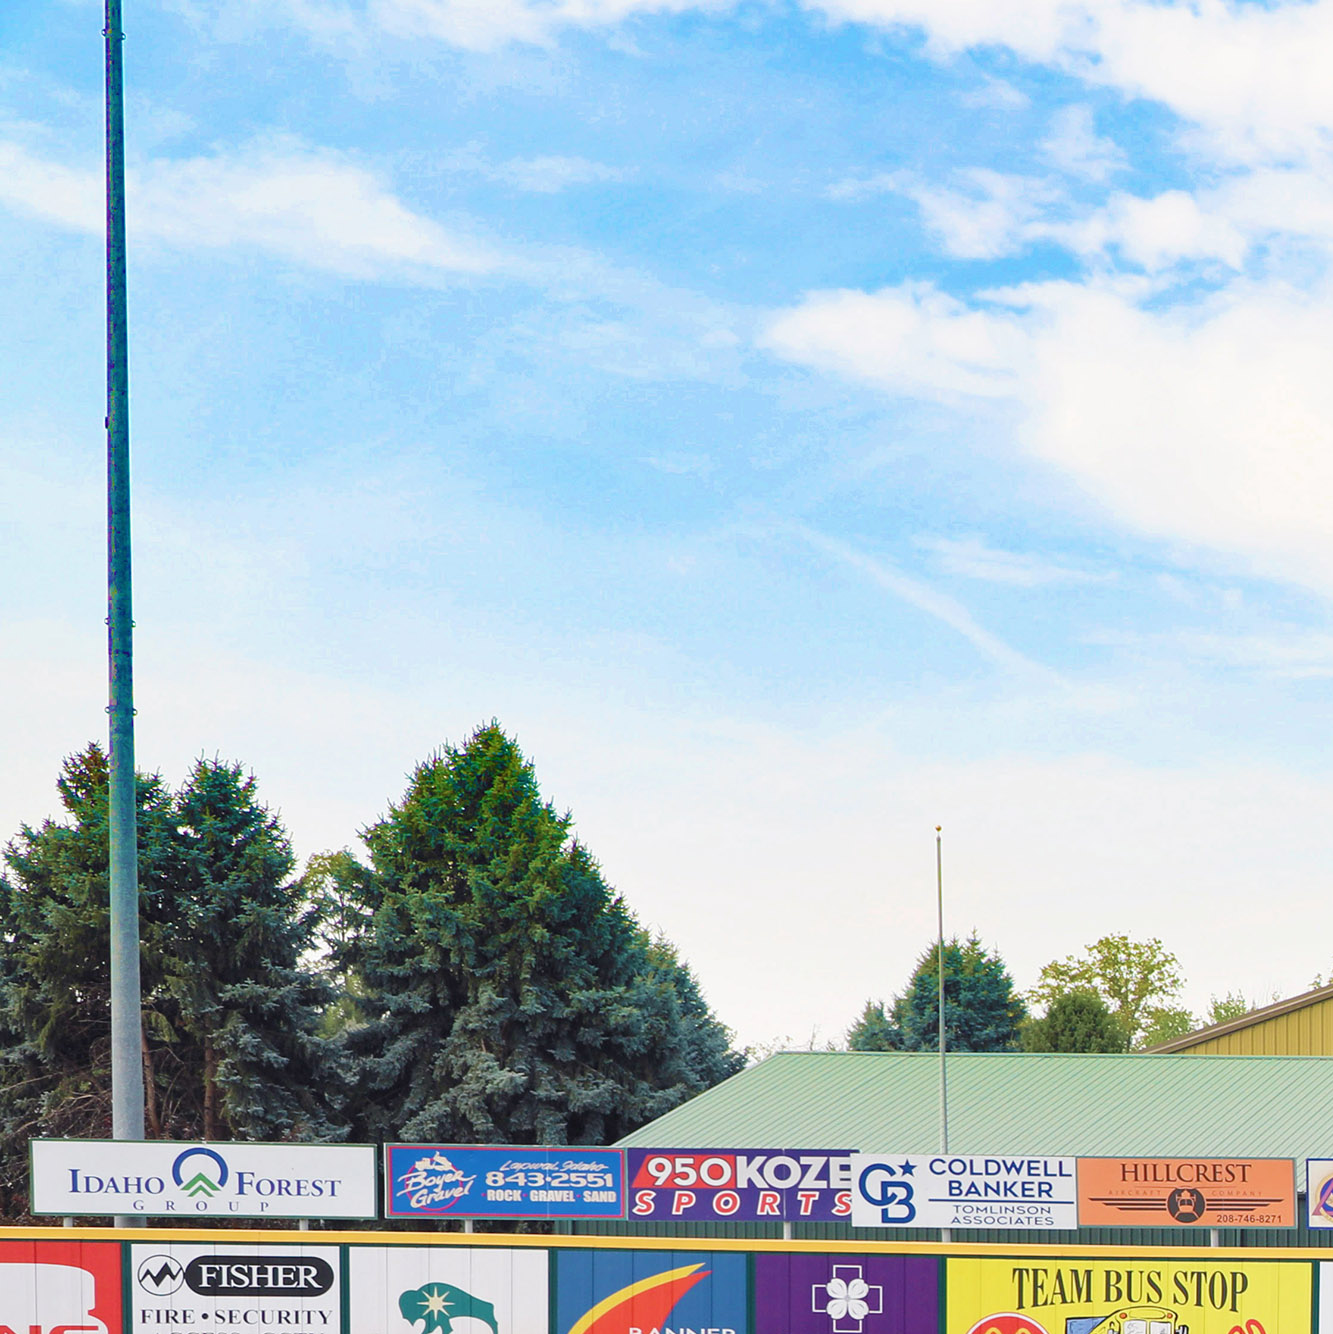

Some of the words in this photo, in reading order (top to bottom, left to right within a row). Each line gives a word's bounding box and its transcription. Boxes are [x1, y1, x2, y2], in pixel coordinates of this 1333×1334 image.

[929, 1158, 1073, 1178] COLDWELL
[1120, 1163, 1252, 1182] HILLCREST
[68, 1168, 164, 1195] IDAHO
[235, 1171, 342, 1197] FOREST
[948, 1180, 1053, 1198] BANKER
[410, 1181, 474, 1208] Gravel
[487, 1190, 522, 1201] ROCK
[530, 1190, 576, 1202] GRAVEL
[583, 1191, 617, 1203] SAND
[632, 1191, 851, 1216] SPORTS
[132, 1200, 270, 1213] GROUP
[953, 1205, 1052, 1215] TOMLINSON
[951, 1216, 1055, 1226] ASSOCIATES
[1216, 1214, 1282, 1224] 208-746-8271
[199, 1264, 323, 1289] FISHER
[1012, 1268, 1094, 1311] TEAM
[1104, 1270, 1162, 1304] BUS
[1173, 1271, 1249, 1312] STOP
[141, 1309, 195, 1325] FIRE
[214, 1310, 333, 1325] SECURITY
